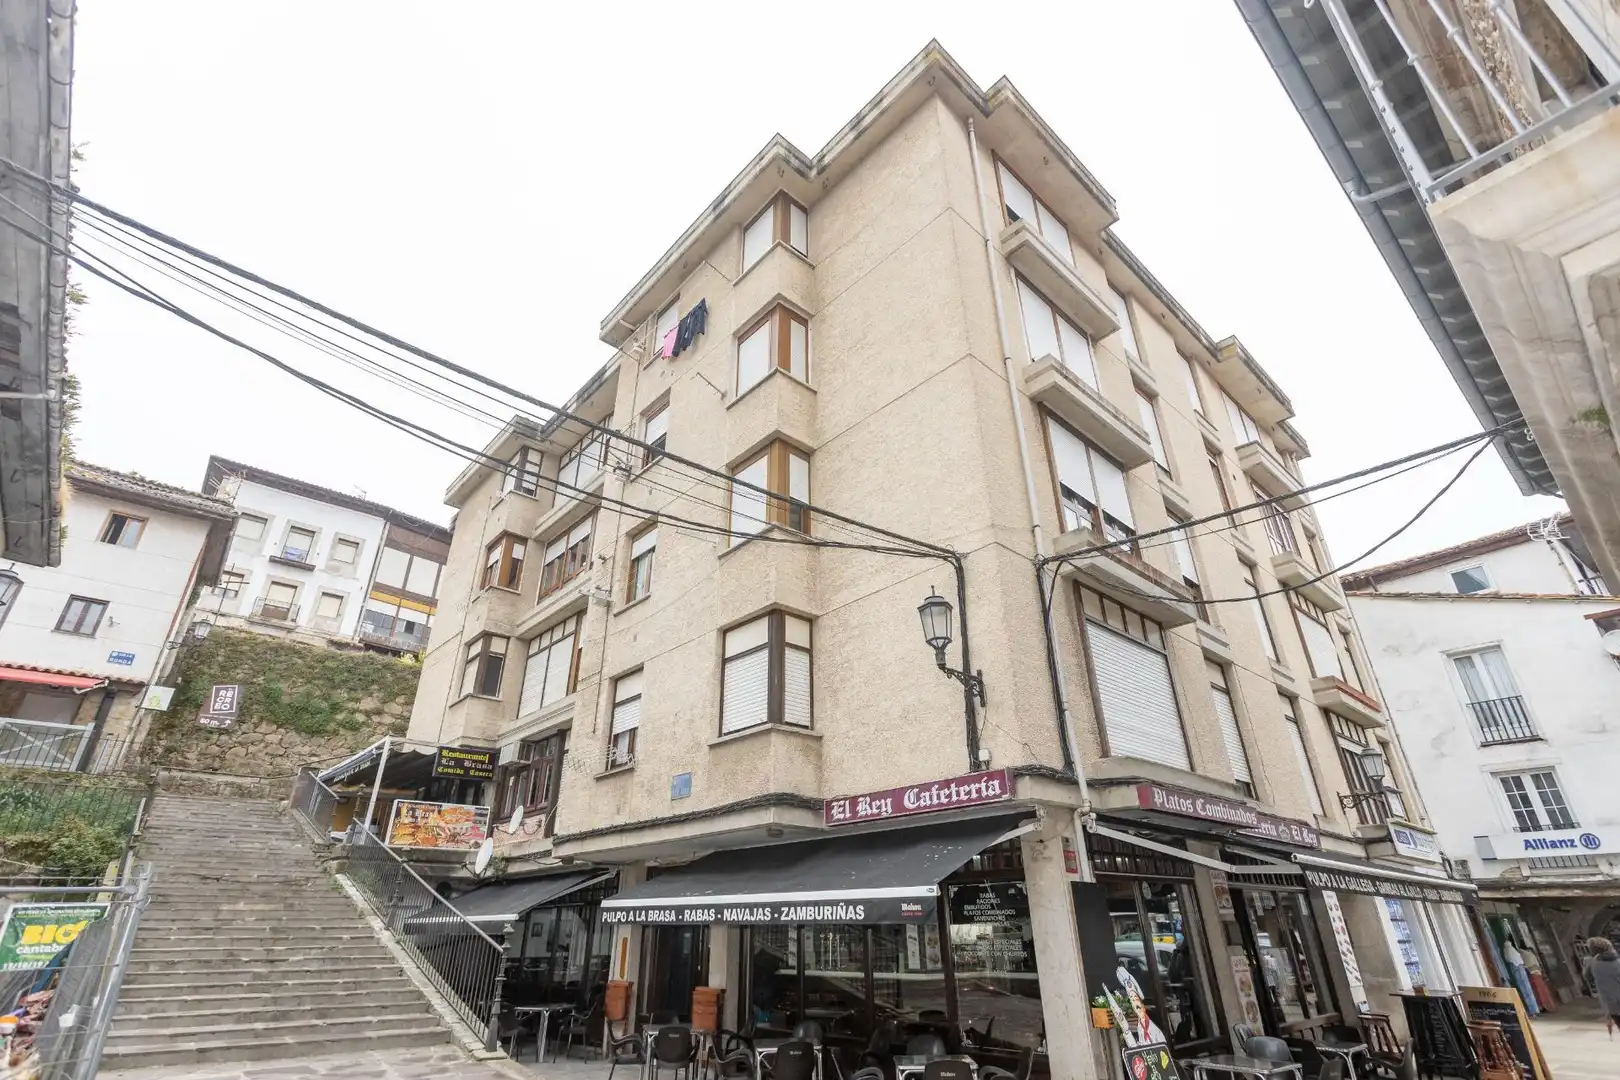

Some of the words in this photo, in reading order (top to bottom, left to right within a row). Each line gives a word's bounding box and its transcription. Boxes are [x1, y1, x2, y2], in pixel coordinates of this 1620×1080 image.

[830, 800, 851, 820] El
[856, 796, 892, 817] Rey
[904, 776, 1002, 810] Cafetería
[1153, 788, 1194, 812] Platos
[1196, 798, 1257, 824] Combinados
[1523, 838, 1578, 850] Allianz
[1305, 870, 1331, 887] PULPO
[1336, 875, 1348, 889] LA
[602, 912, 626, 922] PULPO
[628, 911, 634, 922] A
[636, 911, 646, 922] LA
[648, 910, 676, 922] BRASA
[684, 909, 715, 921] RABAS
[724, 908, 771, 921] NAVAJAS
[780, 902, 864, 920] ZAMBURIÑAS
